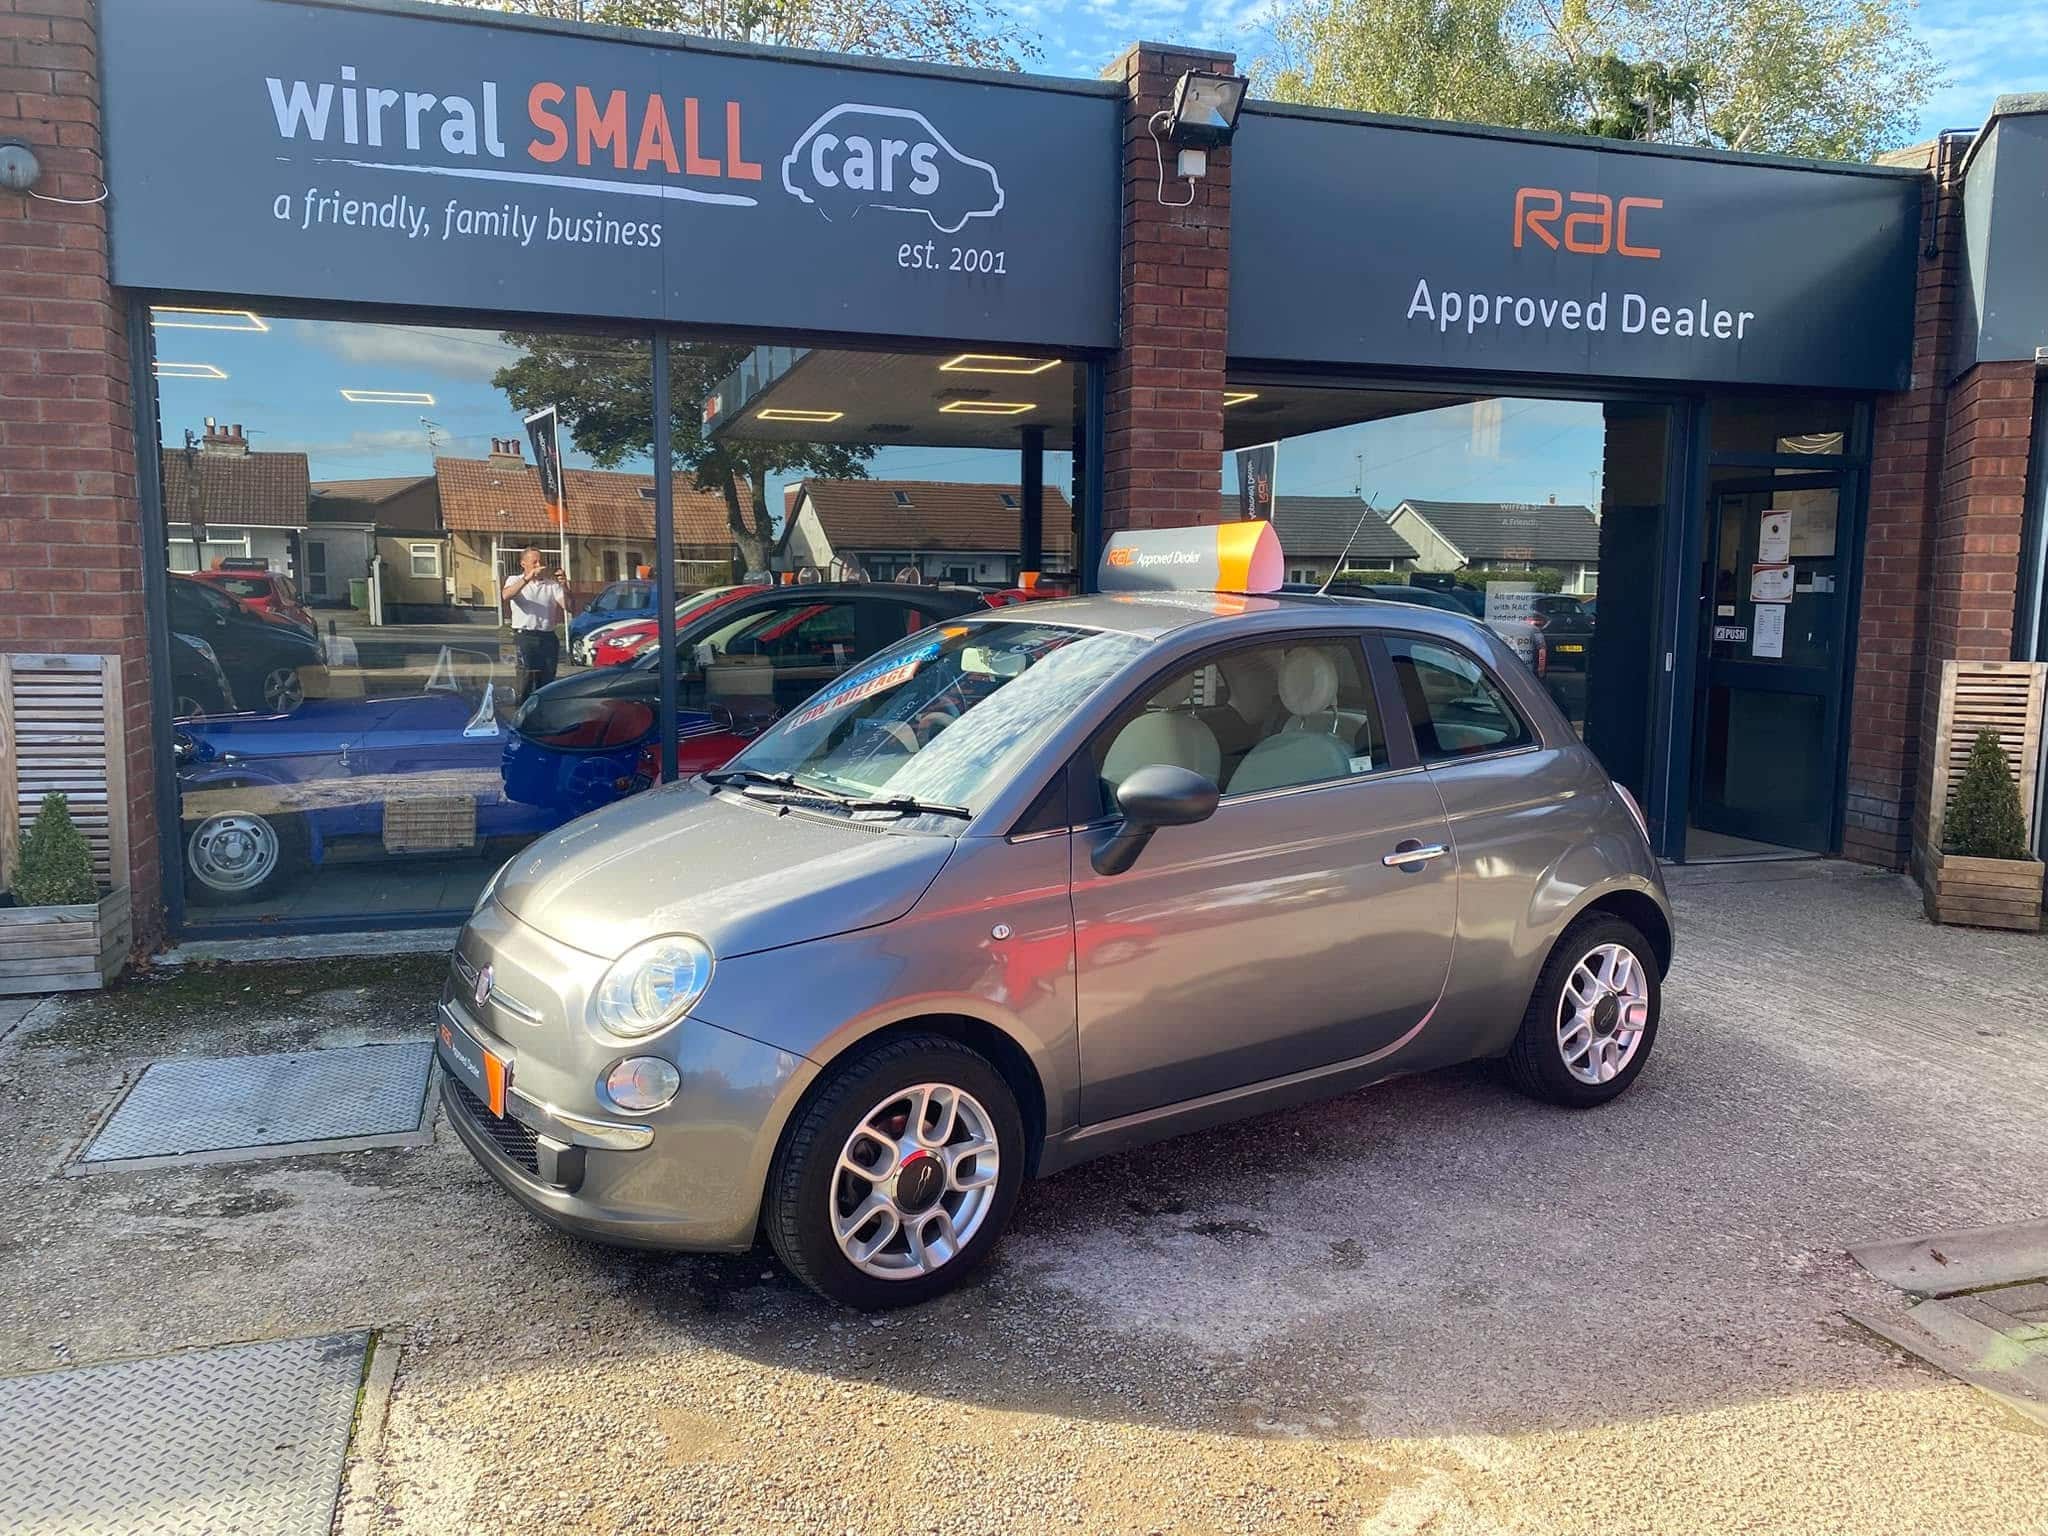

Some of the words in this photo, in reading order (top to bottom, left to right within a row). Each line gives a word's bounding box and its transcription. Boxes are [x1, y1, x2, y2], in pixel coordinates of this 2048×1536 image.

[265, 65, 505, 158] wirral
[529, 83, 762, 180] SMALL
[811, 133, 940, 196] cars
[273, 194, 291, 220] a
[301, 188, 430, 240] friendly,
[442, 199, 538, 246] family
[546, 207, 662, 247] business
[898, 240, 940, 270] est.
[949, 247, 1007, 274] 2001
[1407, 278, 1608, 335] Approved
[1622, 293, 1756, 340] Dealer
[1137, 552, 1174, 568] Approved
[1173, 551, 1200, 564] Dealer
[1725, 627, 1745, 640] PUSH
[792, 701, 829, 729] LOW
[831, 667, 908, 708] MILEAGE
